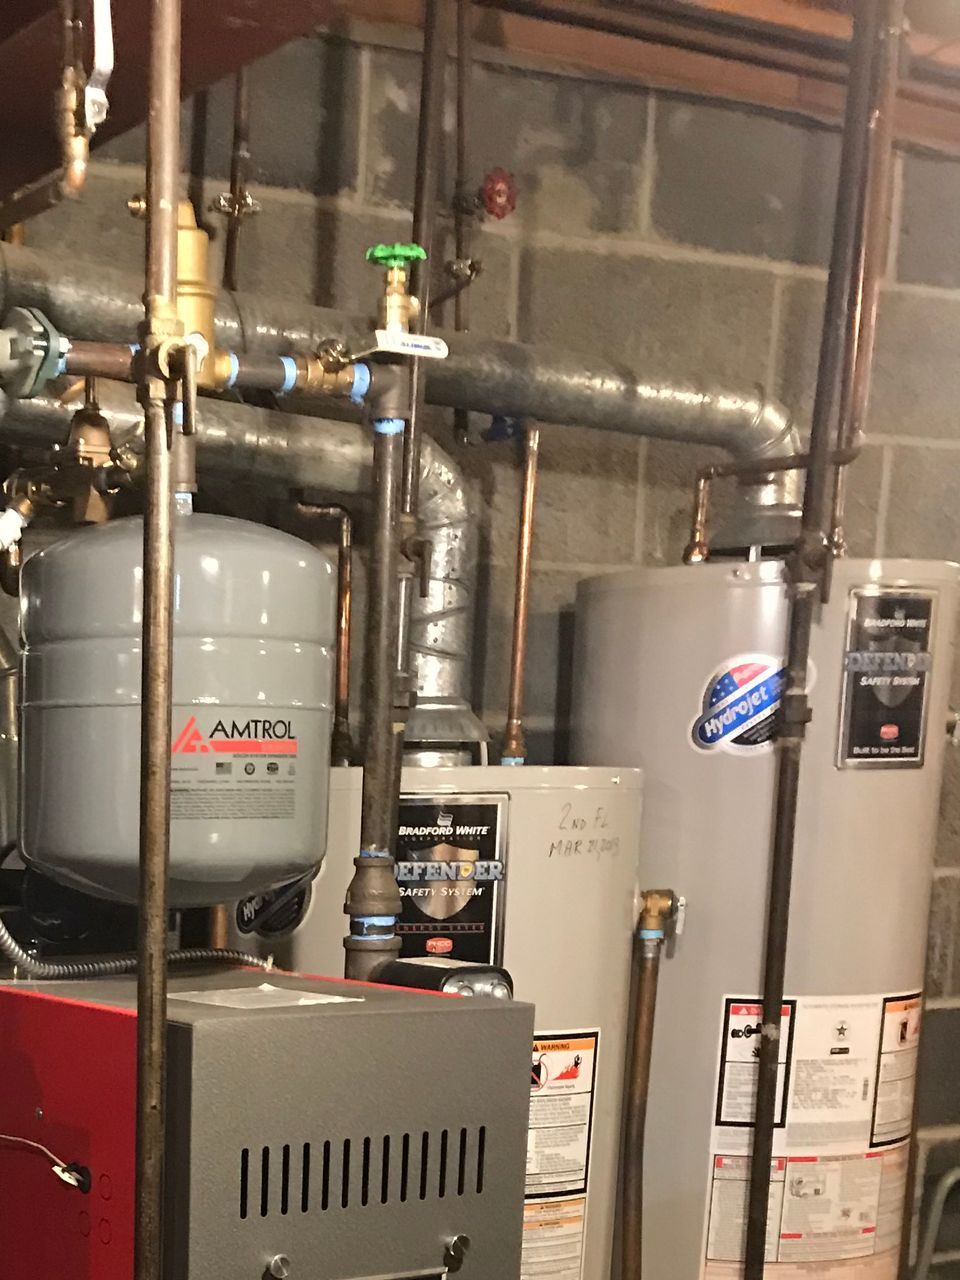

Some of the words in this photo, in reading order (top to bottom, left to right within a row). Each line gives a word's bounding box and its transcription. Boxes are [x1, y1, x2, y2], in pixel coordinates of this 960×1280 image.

[860, 676, 891, 686] SAFETY
[704, 685, 768, 737] Hydrojet
[208, 719, 297, 740] AMTROL
[398, 826, 454, 836] BRADFORD
[456, 826, 489, 836] WHITE
[548, 839, 583, 858] MAR
[394, 861, 504, 881] EFENDER
[398, 887, 437, 897] SAFETY
[440, 887, 483, 897] SYSTEM
[540, 1043, 570, 1051] WARNING
